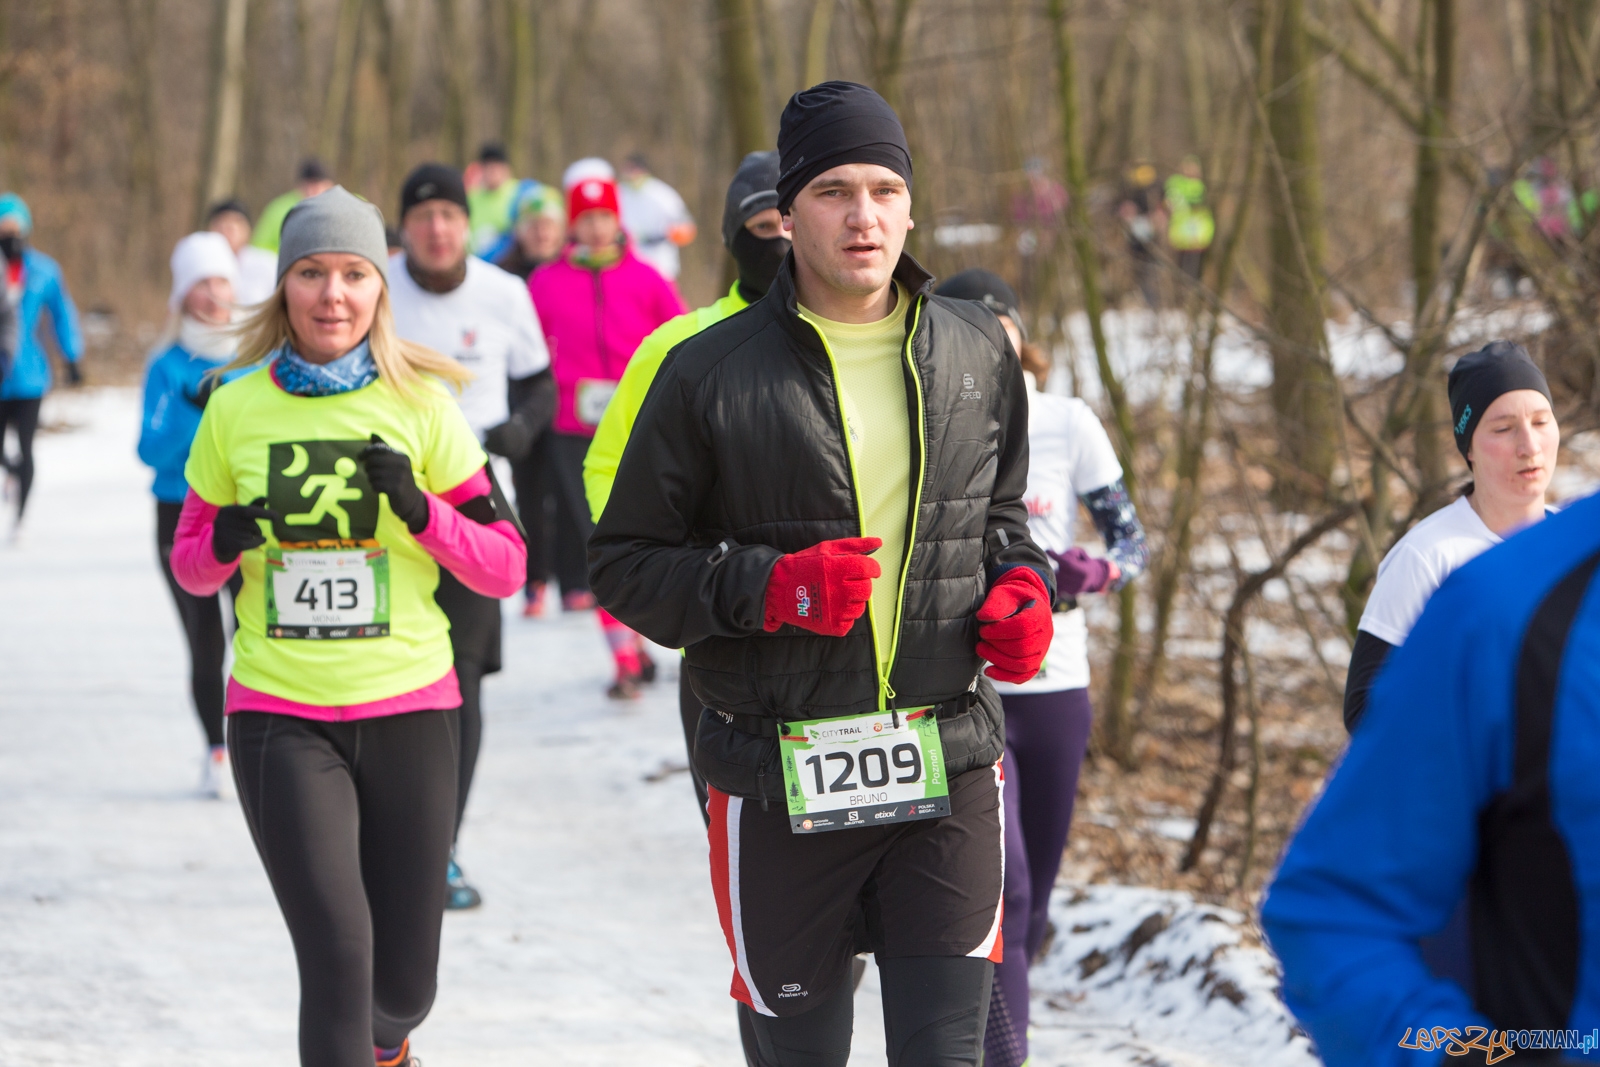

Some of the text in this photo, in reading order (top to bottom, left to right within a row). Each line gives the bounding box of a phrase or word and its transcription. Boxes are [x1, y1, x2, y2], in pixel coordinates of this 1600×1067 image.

[960, 391, 981, 400] SPEED
[294, 578, 358, 610] 413
[312, 614, 341, 623] MONIA
[716, 710, 734, 724] enji
[805, 742, 922, 795] 1209
[927, 749, 942, 785] Poznań
[849, 792, 888, 806] BRUNO
